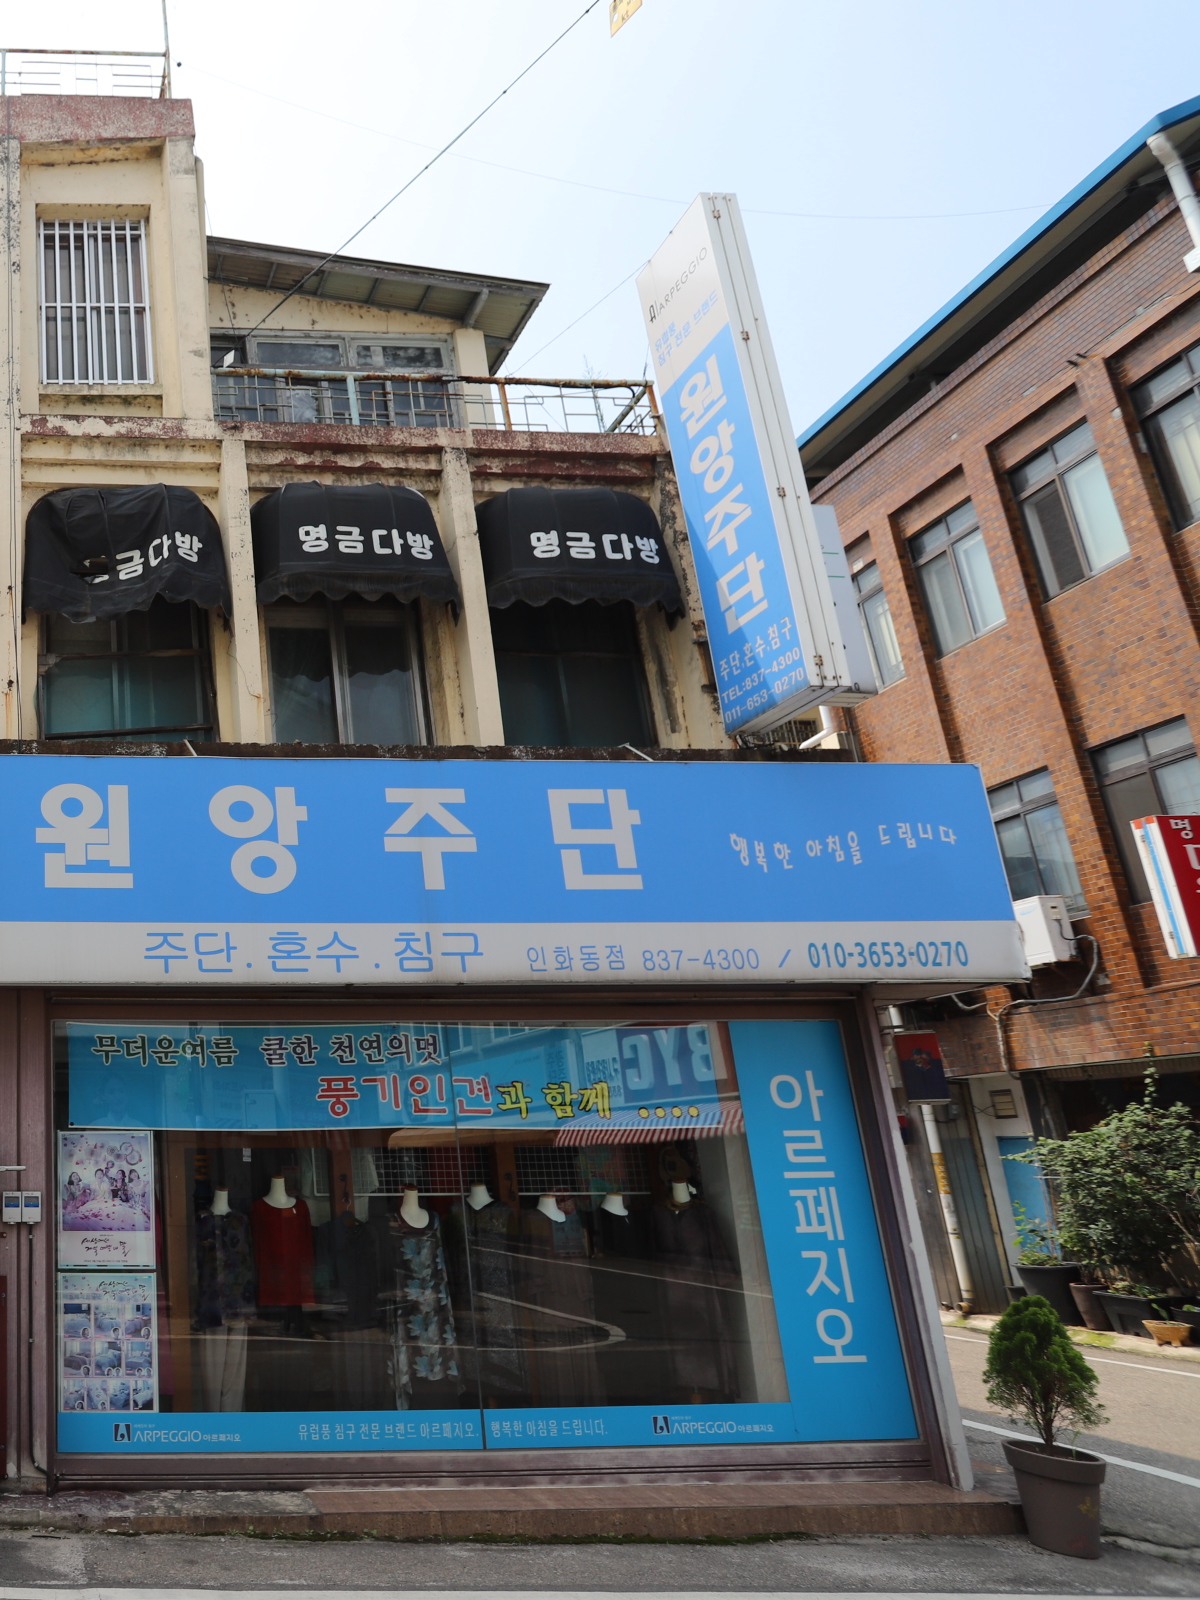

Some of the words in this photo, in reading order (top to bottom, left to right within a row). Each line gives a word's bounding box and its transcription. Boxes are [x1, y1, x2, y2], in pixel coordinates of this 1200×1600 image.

[658, 246, 708, 317] ARPEGGIO
[654, 322, 676, 353] 유럽풍
[658, 343, 673, 367] 침구
[675, 321, 692, 347] 전문
[693, 289, 719, 325] 브랜드
[678, 353, 768, 635] 원앙주단
[82, 530, 203, 584] 금다방
[298, 524, 435, 561] 명금다방
[530, 530, 660, 565] 명금다방
[721, 647, 801, 704] TEL:837-4300
[725, 667, 804, 723] 011-653-0270
[35, 783, 644, 894] 원앙주단
[729, 832, 793, 872] 행복한
[806, 831, 862, 866] 아침을
[878, 821, 958, 848] 드립니다
[526, 944, 627, 972] 인화동점
[642, 948, 760, 971] 837-4300
[807, 941, 969, 969] 010-3653-0270
[91, 1034, 239, 1067] 무더운여름
[260, 1033, 320, 1067] 쿨한
[329, 1032, 441, 1067] 천연의멋
[542, 1081, 612, 1119] 함께
[769, 1070, 868, 1364] 아르페지오
[133, 1430, 202, 1442] ARPEGGIO
[202, 1433, 242, 1442] 아르페지오
[298, 1423, 330, 1441] 유럽풍
[334, 1423, 356, 1440] 침구
[359, 1423, 381, 1440] 전문
[384, 1423, 416, 1440] 브랜드
[420, 1421, 480, 1439] 아르페지오.
[490, 1420, 523, 1438] 행복한
[526, 1420, 559, 1437] 아침을
[561, 1418, 609, 1437] 드립니다.
[672, 1421, 737, 1435] ARPEGGIO
[737, 1424, 775, 1433] 아르페지오
